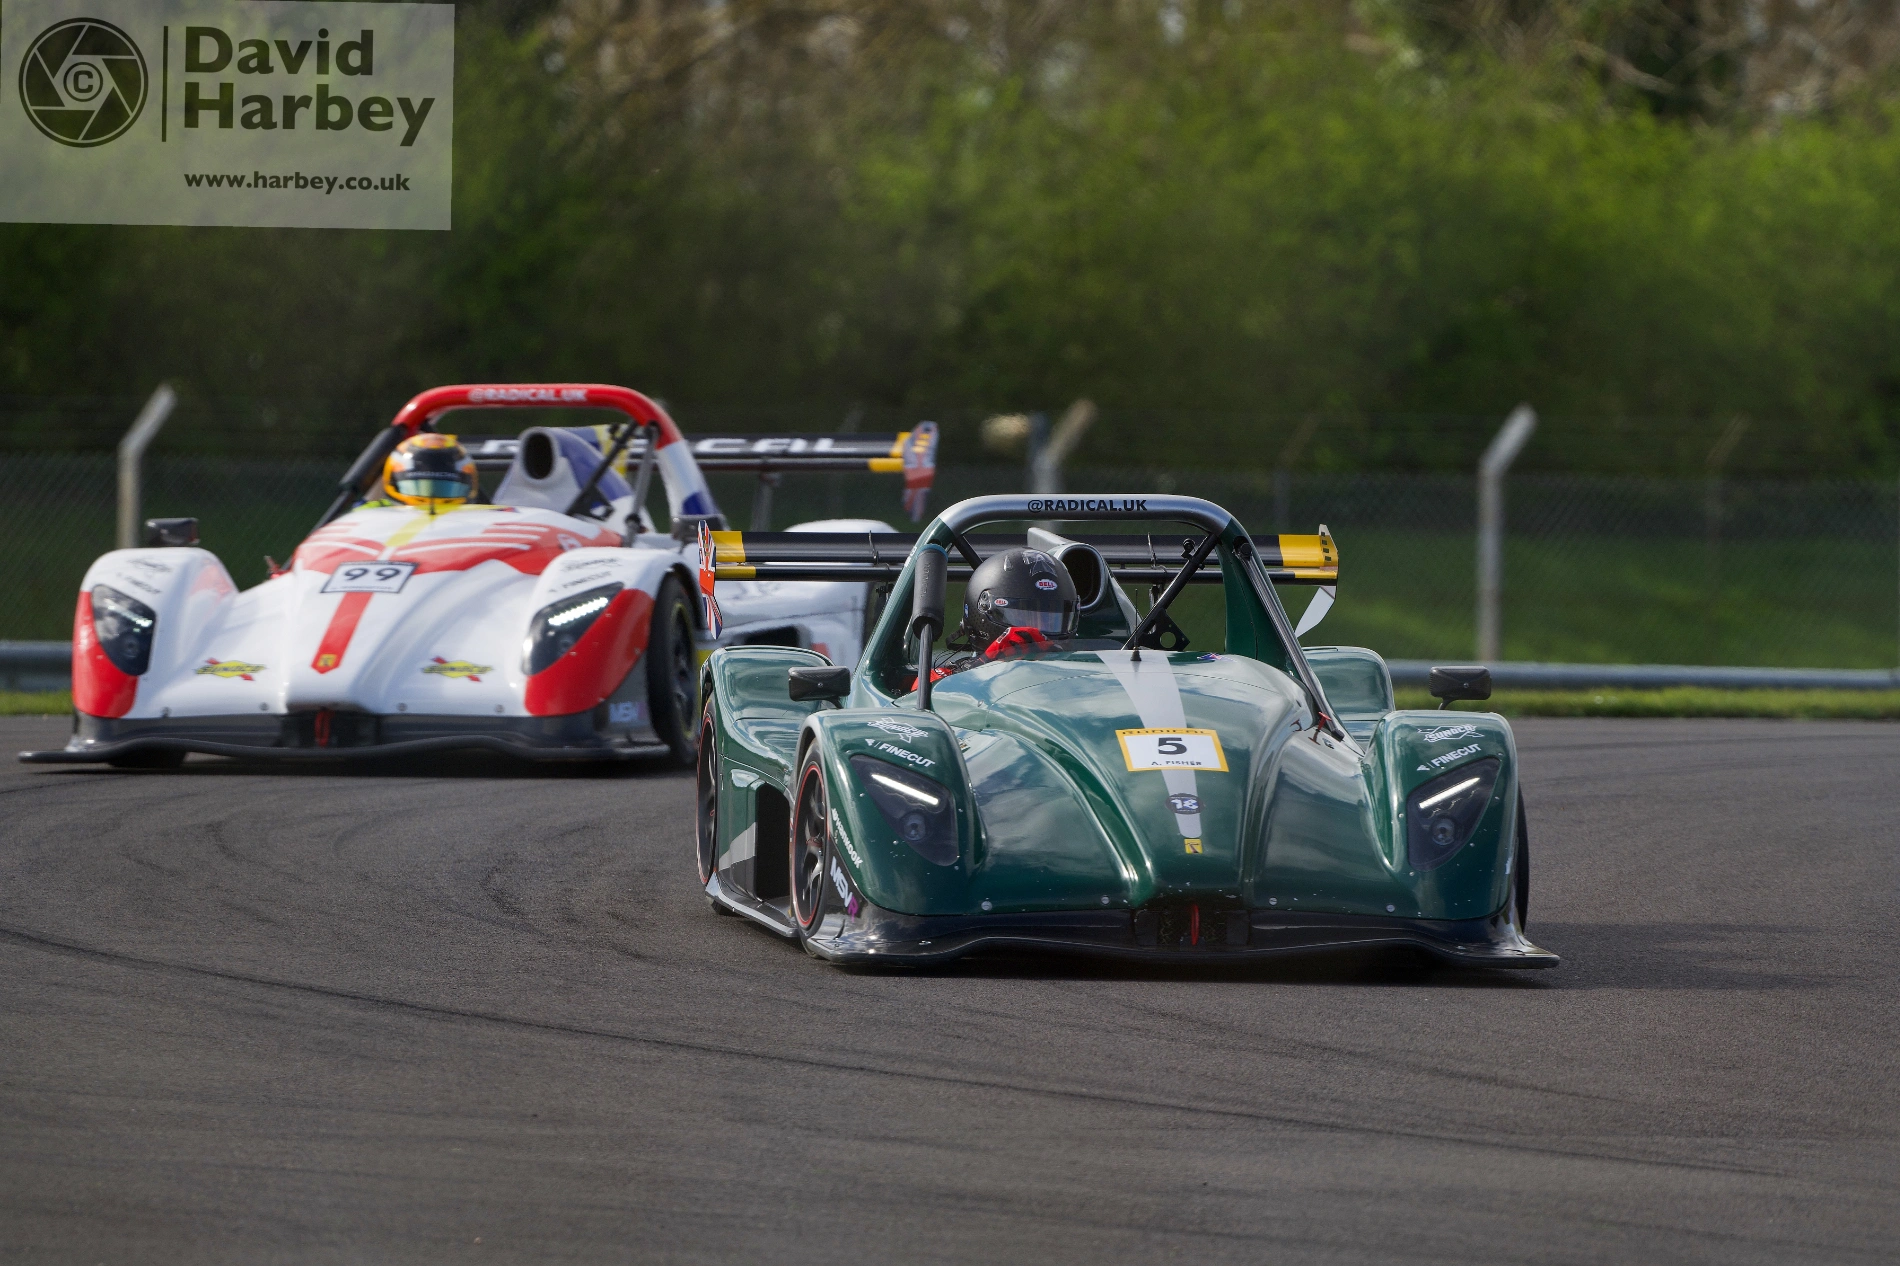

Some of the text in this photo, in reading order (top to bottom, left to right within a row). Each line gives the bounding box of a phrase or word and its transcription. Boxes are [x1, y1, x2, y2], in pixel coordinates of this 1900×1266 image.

[1027, 499, 1148, 513] @RADICAL.UK
[344, 567, 401, 581] 99
[878, 743, 935, 767] FINECUT
[1157, 737, 1188, 755] 5
[1430, 744, 1482, 767] FINECUT
[830, 856, 859, 916] MSVR
